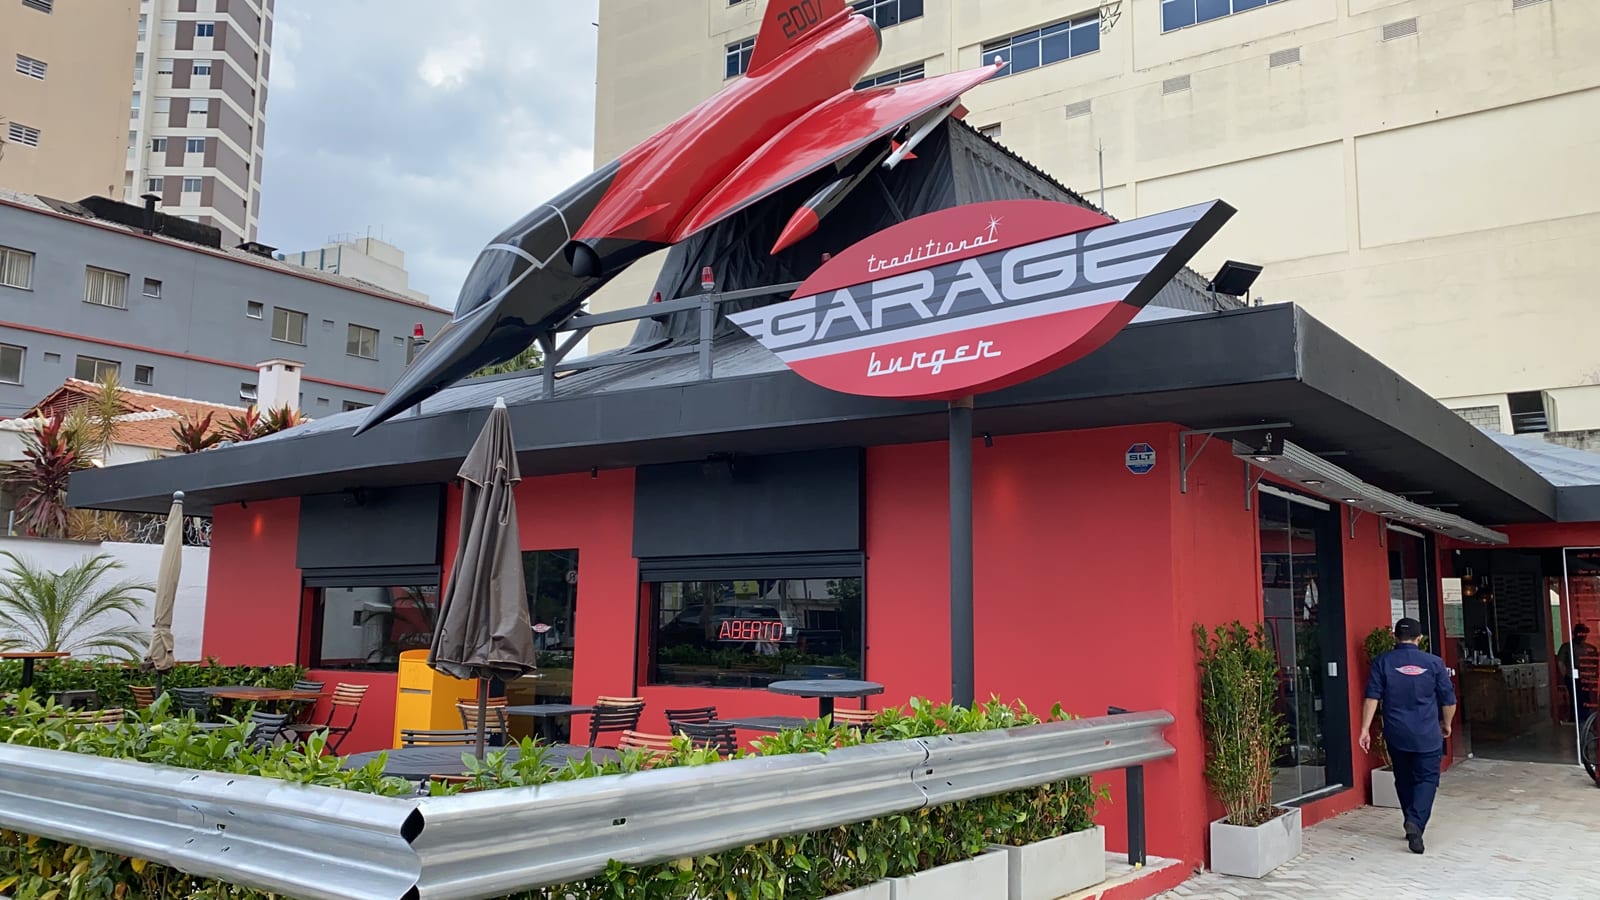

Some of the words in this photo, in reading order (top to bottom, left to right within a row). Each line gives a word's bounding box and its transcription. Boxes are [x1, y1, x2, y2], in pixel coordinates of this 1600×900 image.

[867, 216, 1001, 273] traditional
[760, 201, 1212, 344] GARAGE
[867, 340, 1002, 377] burger
[1129, 453, 1153, 462] SLT
[719, 620, 783, 641] ABERTO
